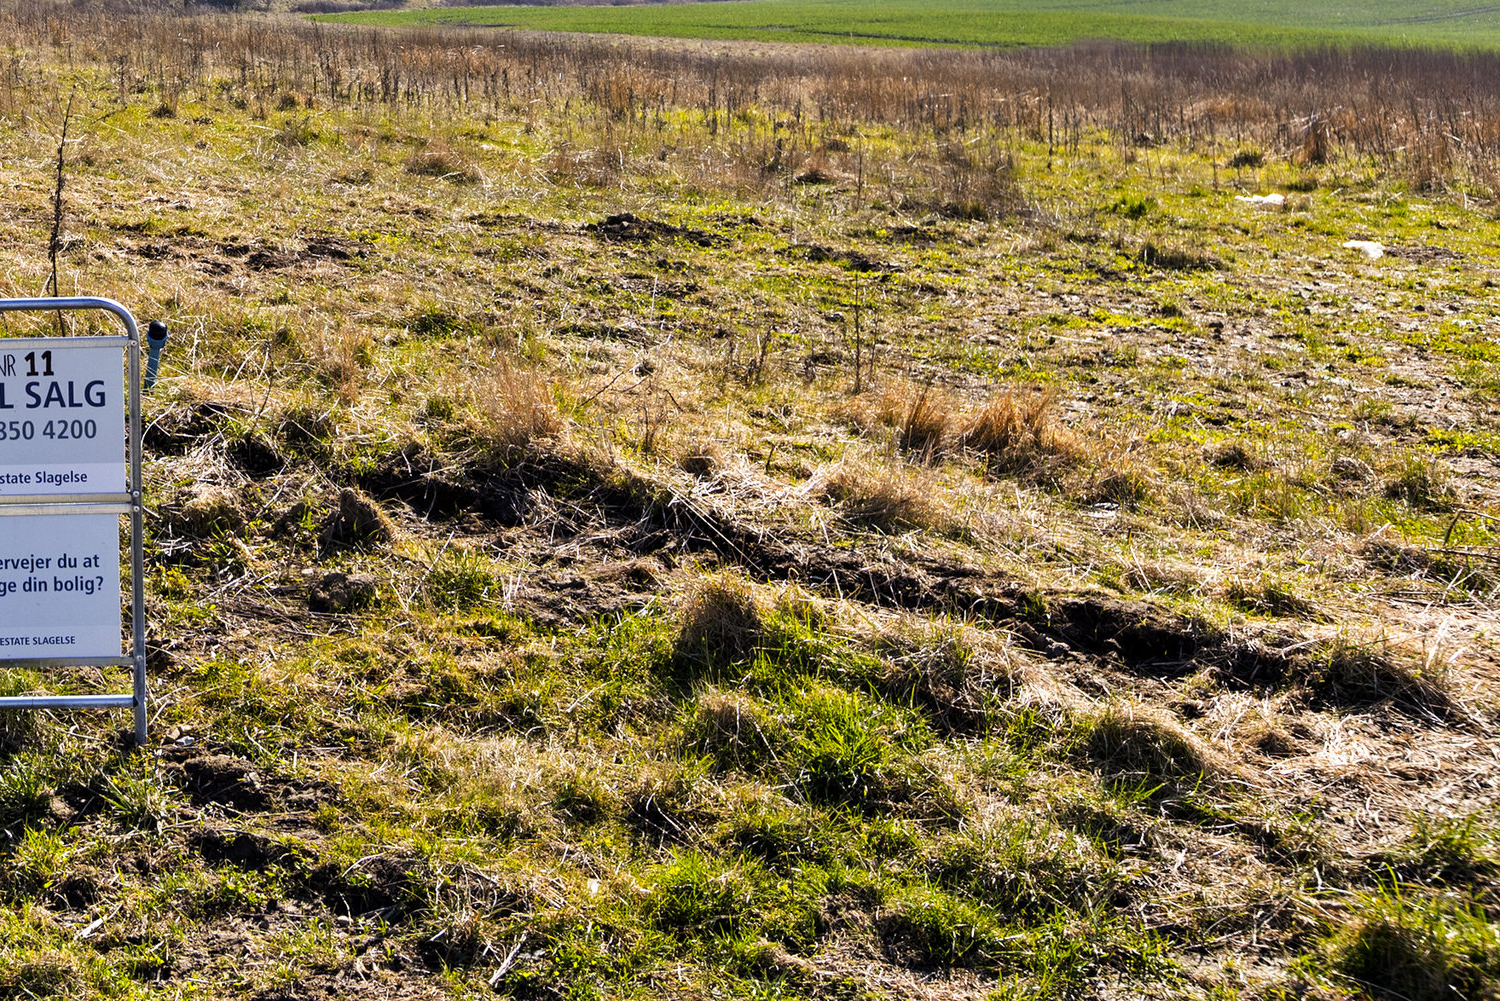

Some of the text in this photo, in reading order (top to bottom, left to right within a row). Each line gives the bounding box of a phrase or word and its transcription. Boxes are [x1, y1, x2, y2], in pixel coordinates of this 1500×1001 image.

[24, 351, 54, 376] 11
[25, 380, 106, 409] SALG
[43, 419, 96, 439] 4200
[35, 471, 88, 485] Slagelse
[57, 554, 77, 568] du
[83, 555, 99, 568] at
[22, 577, 48, 592] din
[53, 576, 103, 595] bolig?
[0, 636, 75, 645] ESTATE SLAGELSE
